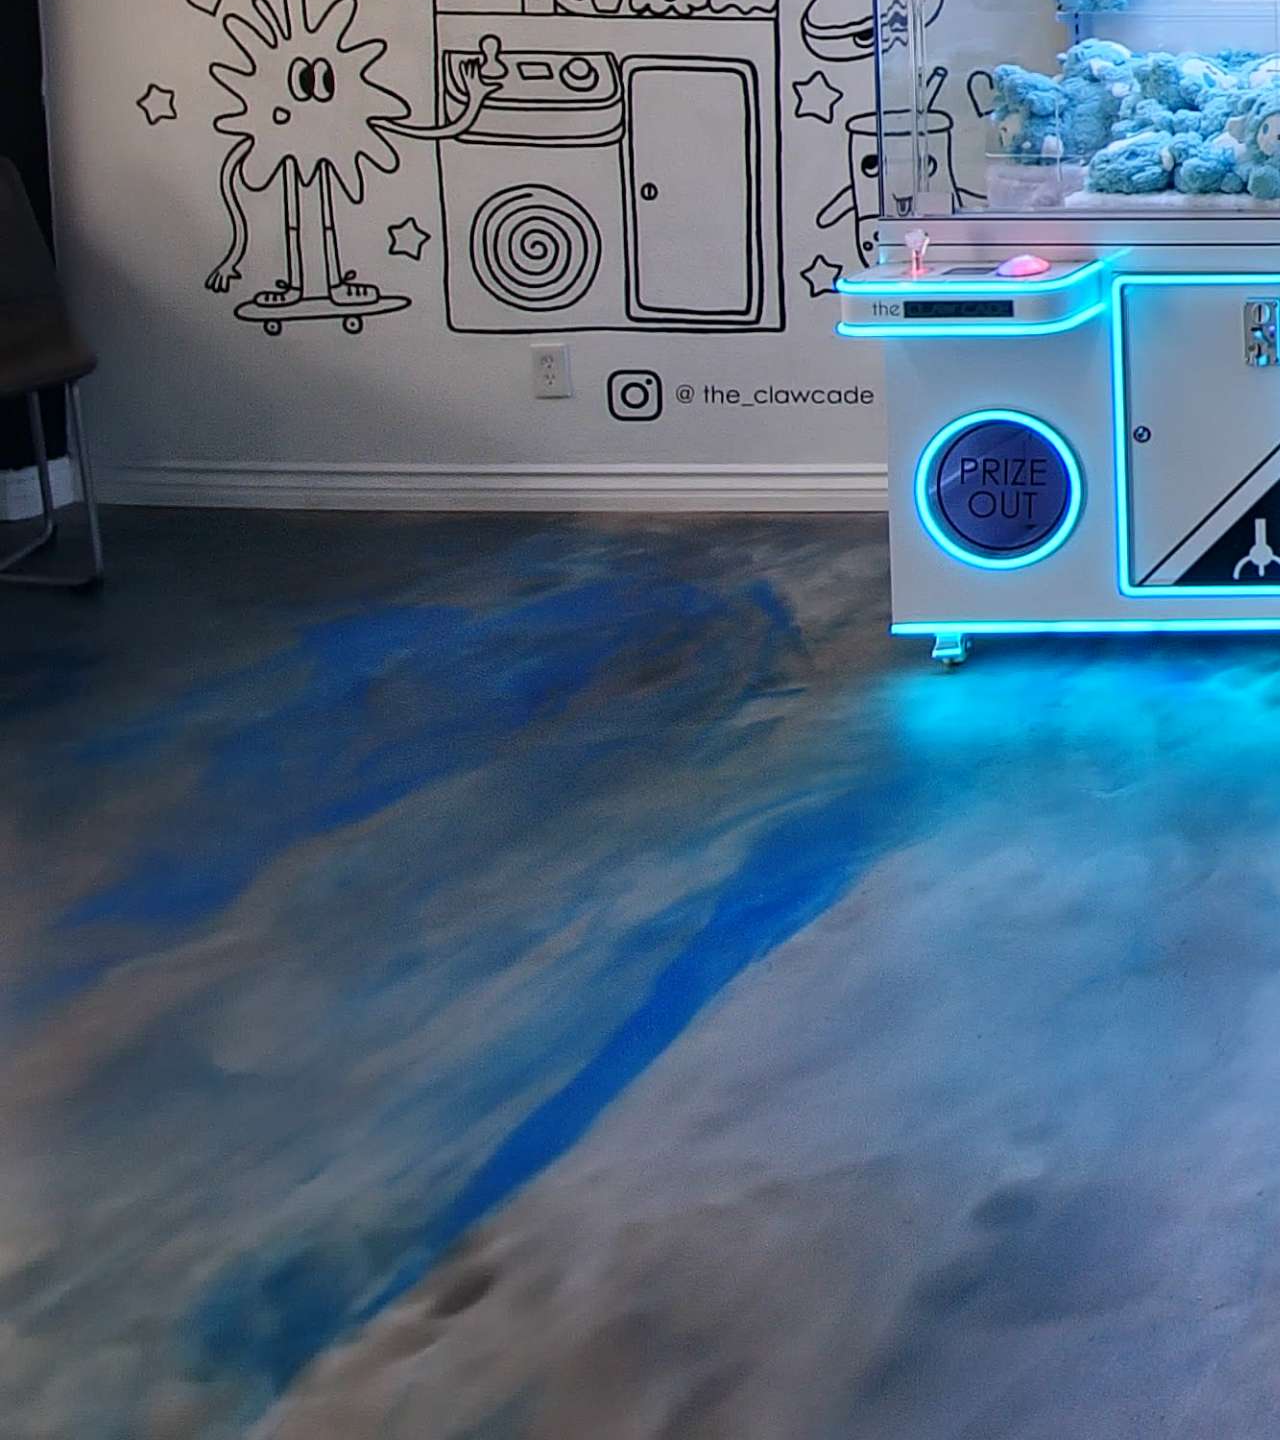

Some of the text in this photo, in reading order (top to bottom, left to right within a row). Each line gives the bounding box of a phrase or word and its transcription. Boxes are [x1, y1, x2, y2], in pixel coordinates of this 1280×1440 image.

[872, 300, 900, 317] the
[675, 383, 875, 407] @ the_clawcade
[960, 457, 1047, 486] PRIZE
[968, 491, 1038, 519] OUT
